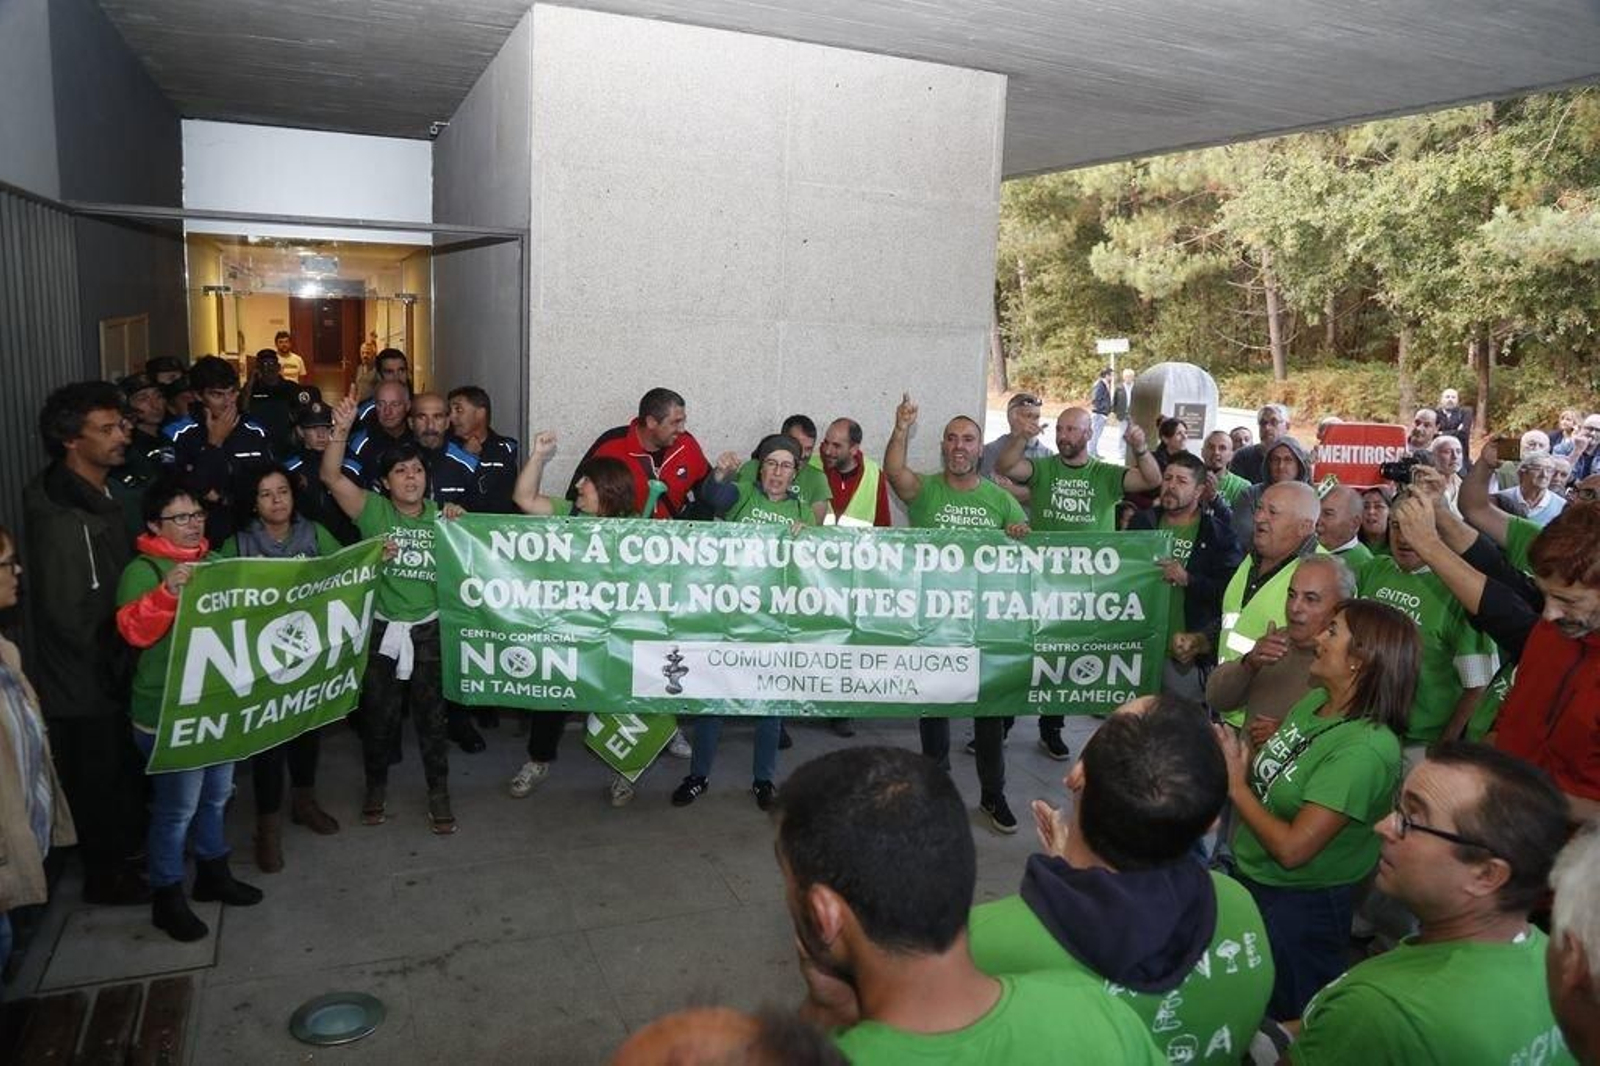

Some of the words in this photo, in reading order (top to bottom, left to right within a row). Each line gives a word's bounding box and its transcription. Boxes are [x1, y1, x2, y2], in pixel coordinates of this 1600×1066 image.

[1051, 493, 1091, 513] NON
[489, 530, 574, 562] NON
[619, 532, 906, 571] CONSTRUCCIÓN
[914, 543, 965, 573] DO
[973, 546, 1121, 575] CENTRO
[196, 588, 280, 614] CENTRO
[286, 564, 377, 604] COMERCIAL
[460, 577, 679, 613] COMERCIAL
[687, 583, 761, 615] NOS
[769, 586, 916, 618] MONTES
[925, 589, 974, 619] DE
[981, 591, 1145, 621] TAMEIGA
[178, 589, 375, 706] NON
[460, 628, 506, 641] CENTRO
[509, 632, 577, 643] COMERCIAL
[1034, 642, 1080, 652] CENTRO
[1082, 642, 1143, 651] COMERCIAL
[460, 641, 578, 682] NON
[708, 650, 853, 670] COMUNIDADE
[860, 654, 888, 670] DE
[894, 654, 969, 673] AUGAS
[1031, 653, 1142, 687] NON
[460, 680, 485, 692] EN
[490, 681, 576, 699] TAMEIGA
[757, 674, 833, 693] MONTE
[840, 675, 919, 696] BAXIÑA
[1028, 690, 1051, 703] EN
[1056, 690, 1137, 704] TAMEIGA
[169, 713, 229, 748] EN
[240, 667, 359, 734] TAMEIGA
[605, 714, 649, 760] EN
